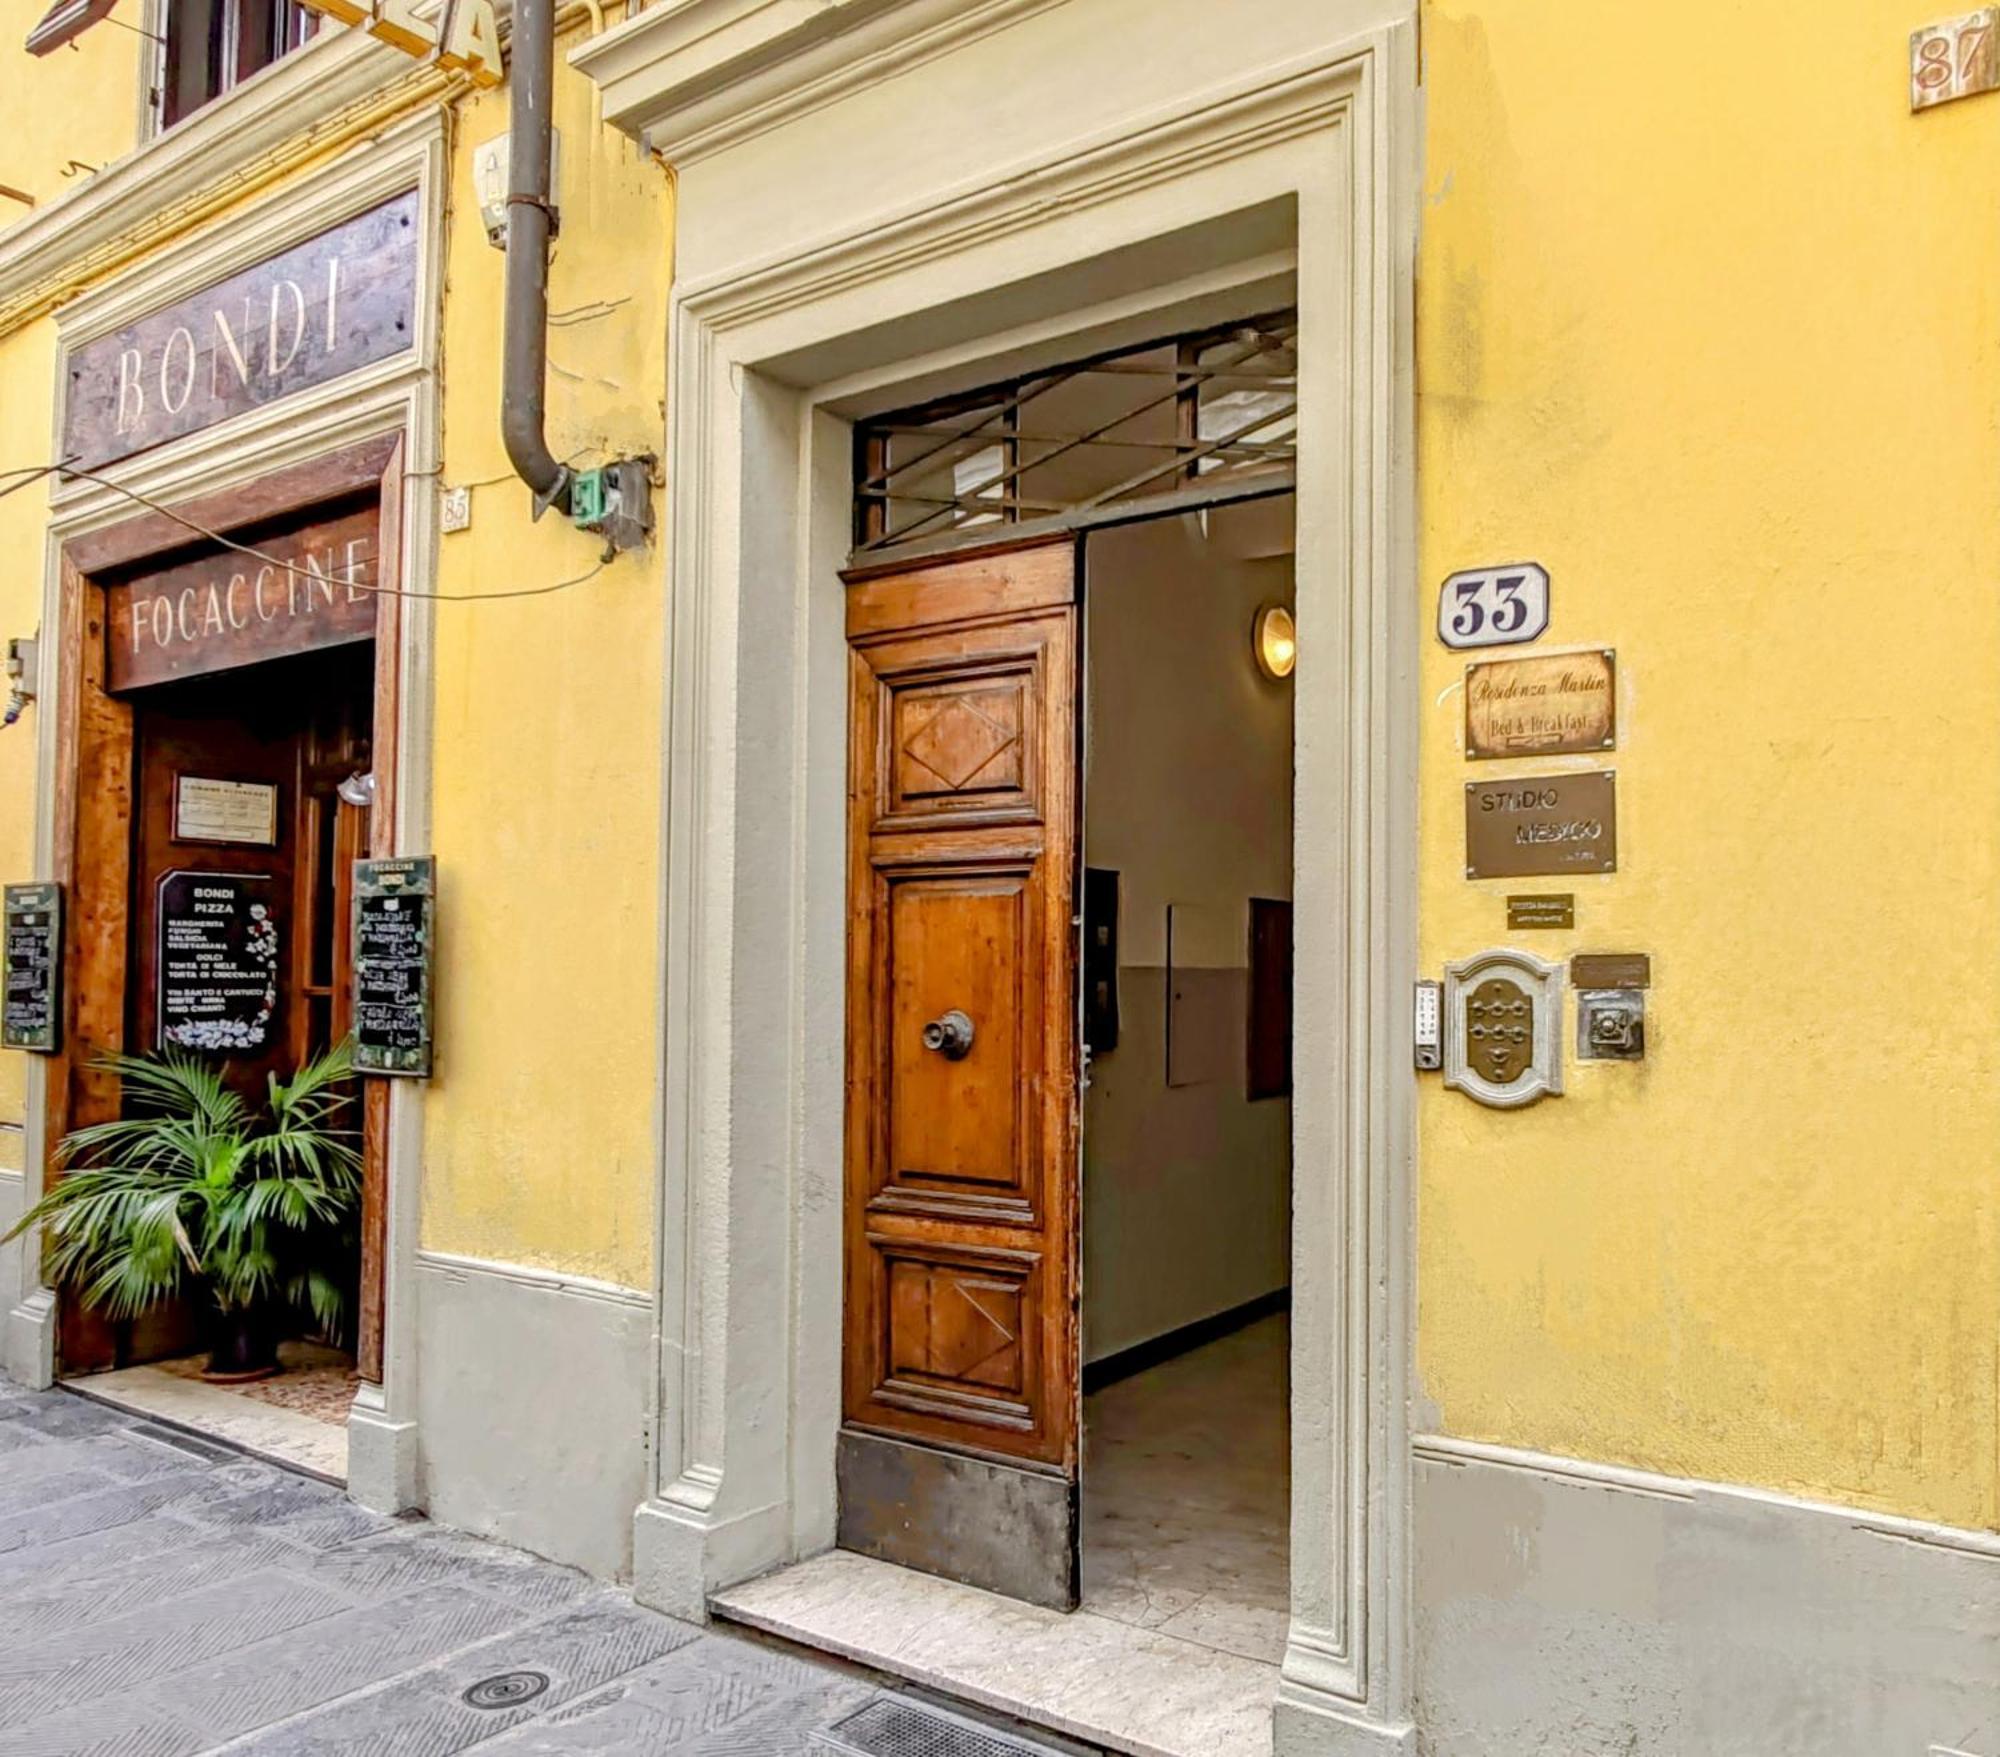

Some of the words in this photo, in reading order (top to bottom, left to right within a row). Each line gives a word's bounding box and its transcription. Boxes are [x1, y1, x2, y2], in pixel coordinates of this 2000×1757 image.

[1916, 23, 1991, 90] 87
[116, 257, 339, 435] BONDI
[445, 489, 466, 523] 85
[131, 538, 369, 654] FOCACCINE
[1452, 575, 1528, 636] 33
[1473, 678, 1547, 704] Residenza
[1558, 672, 1606, 694] Martin
[1492, 718, 1512, 736] Bed
[1531, 713, 1587, 734] Breakfast
[1481, 789, 1558, 812] STUDIO
[194, 888, 234, 899] BONDI
[194, 903, 234, 914] PIZZA
